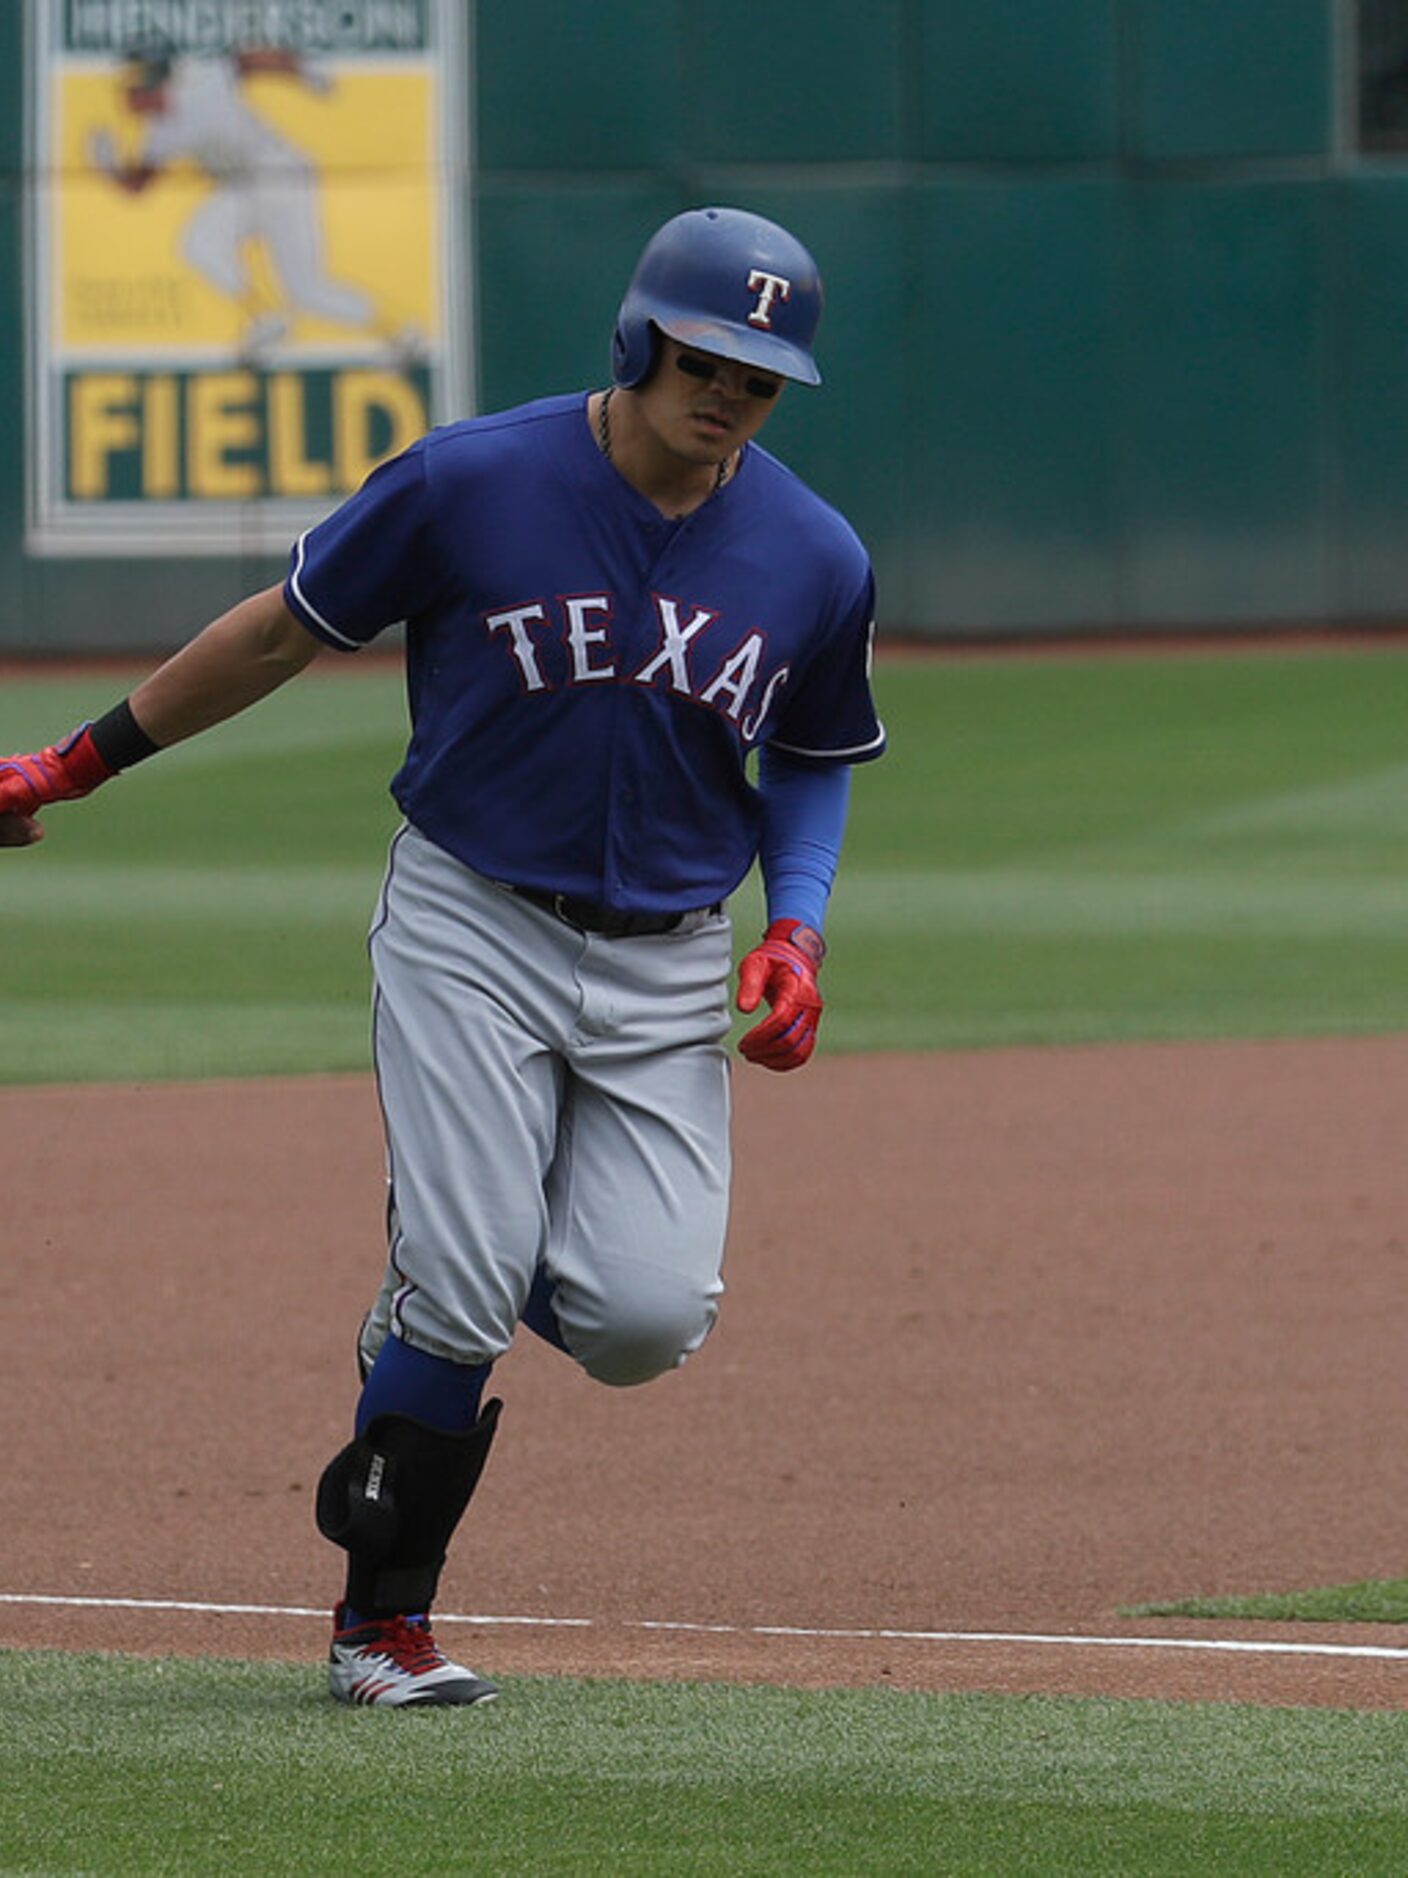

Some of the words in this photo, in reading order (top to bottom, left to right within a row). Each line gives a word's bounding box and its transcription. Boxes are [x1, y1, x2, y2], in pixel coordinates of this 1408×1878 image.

[747, 268, 791, 330] T
[70, 368, 428, 498] FIELD
[482, 593, 790, 743] TEXAS
